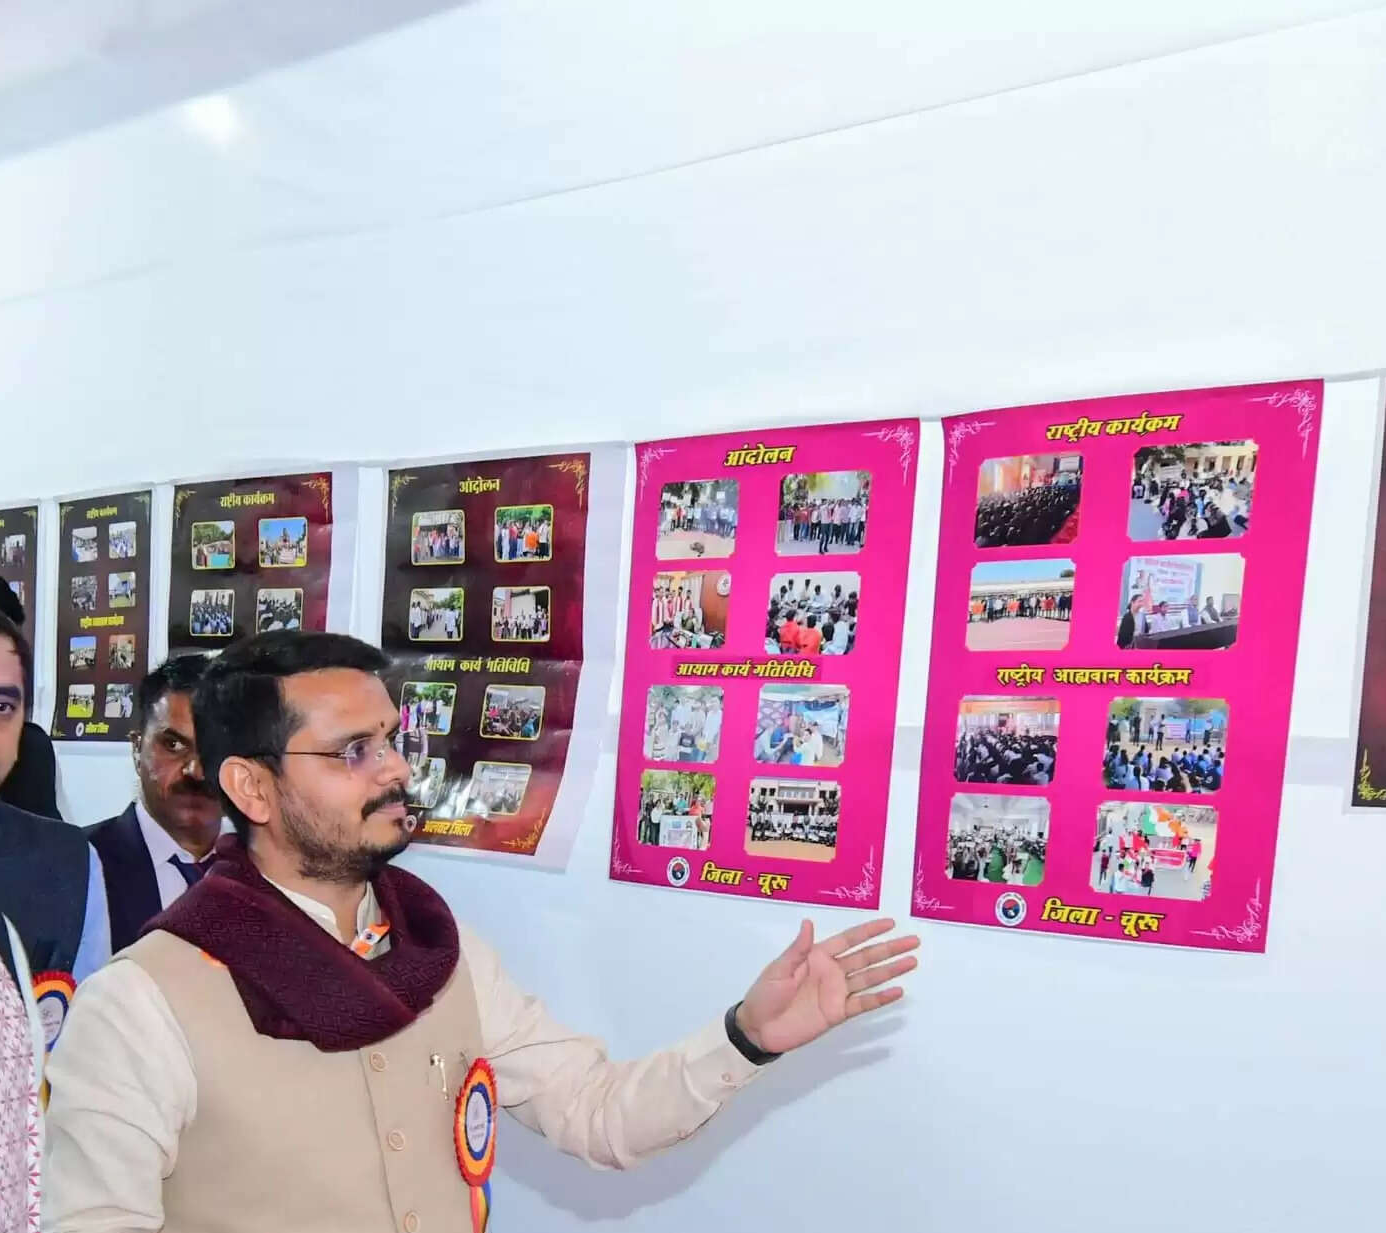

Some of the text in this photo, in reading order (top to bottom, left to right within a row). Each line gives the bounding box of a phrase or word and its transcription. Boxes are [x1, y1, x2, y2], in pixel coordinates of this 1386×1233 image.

[1045, 411, 1184, 442] राष्ट्रीय कार्यक्रम
[724, 443, 796, 467] आंदोलन
[459, 477, 501, 494] आंदोलन
[676, 660, 817, 678] आयाम कार्य गतिविधि
[996, 663, 1046, 687] राष्ट्रीय
[1125, 663, 1193, 686] कार्यक्रम
[700, 860, 744, 886] जिला
[757, 873, 792, 897] चूरू
[1041, 897, 1102, 927] जिला
[1120, 911, 1166, 938] चूरू
